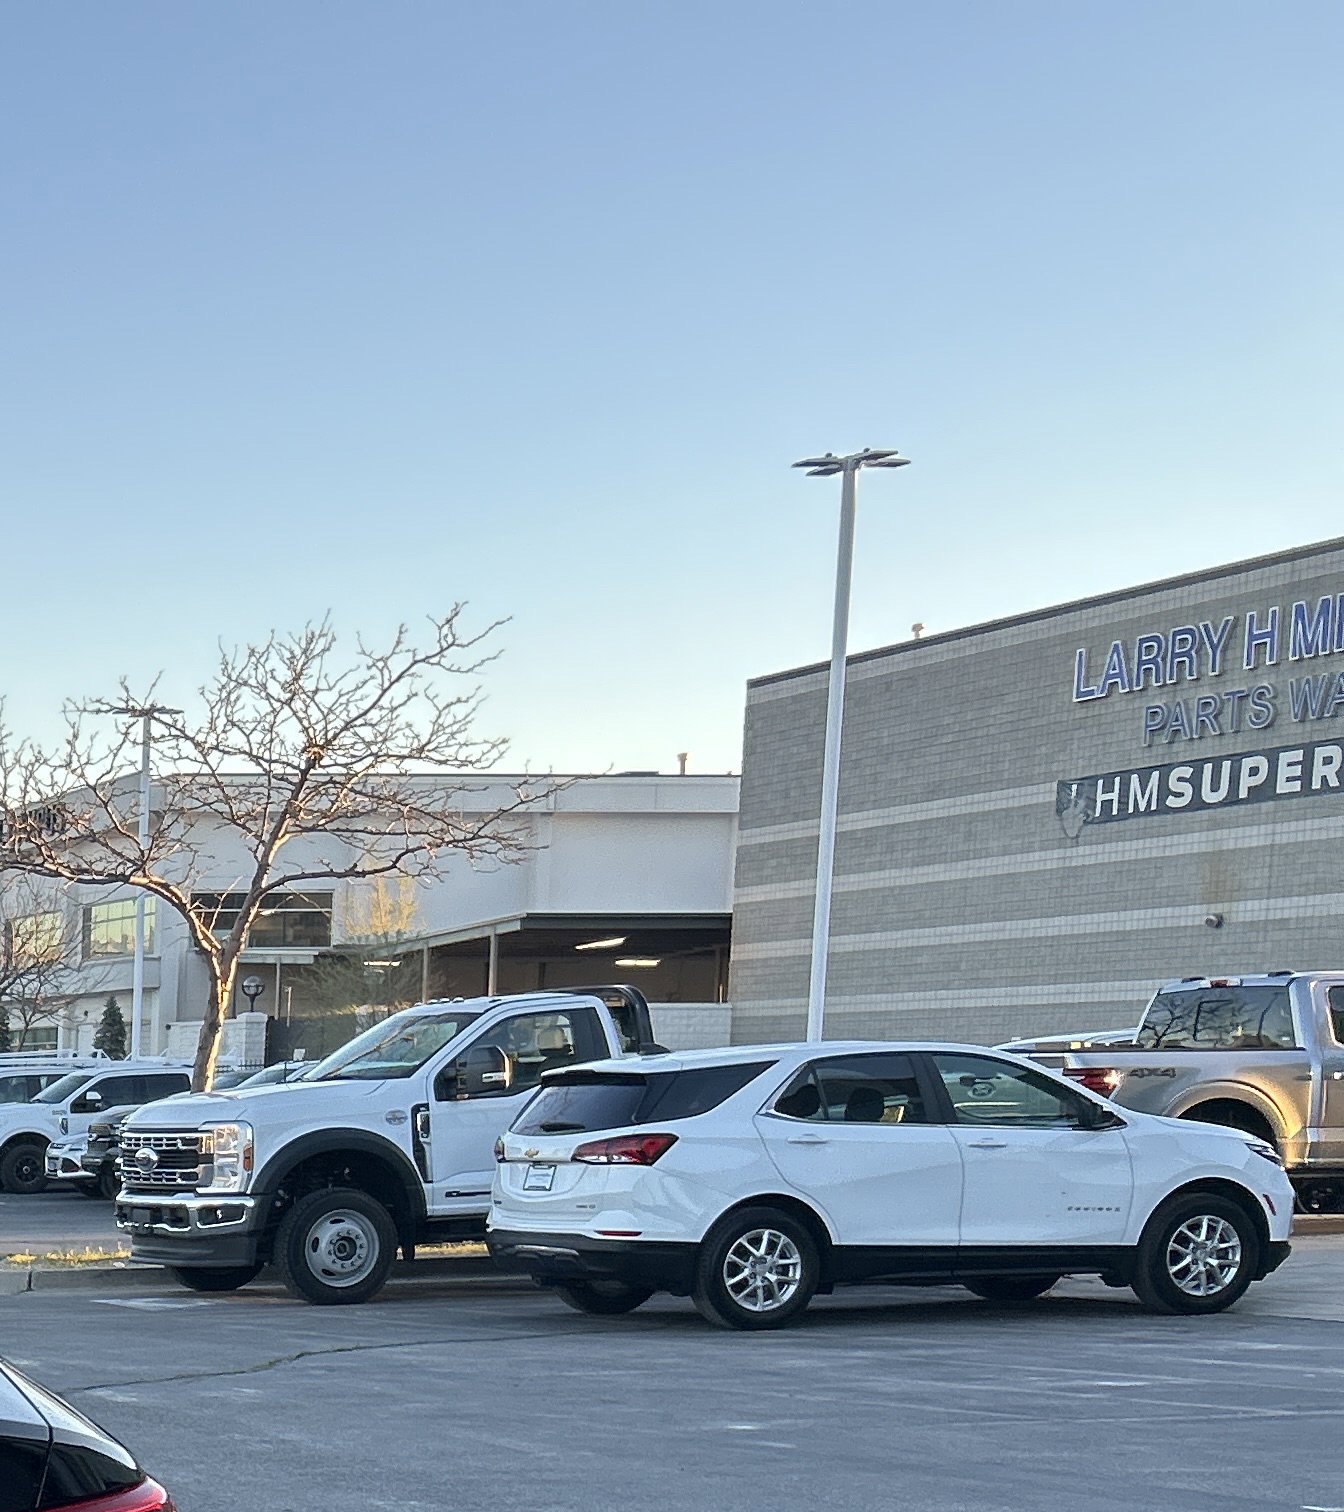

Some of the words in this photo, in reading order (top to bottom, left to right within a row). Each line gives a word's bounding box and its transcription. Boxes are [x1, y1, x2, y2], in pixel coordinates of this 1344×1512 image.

[1073, 616, 1235, 702] LARRY
[1243, 606, 1279, 670] H
[1141, 683, 1275, 748] PARTS
